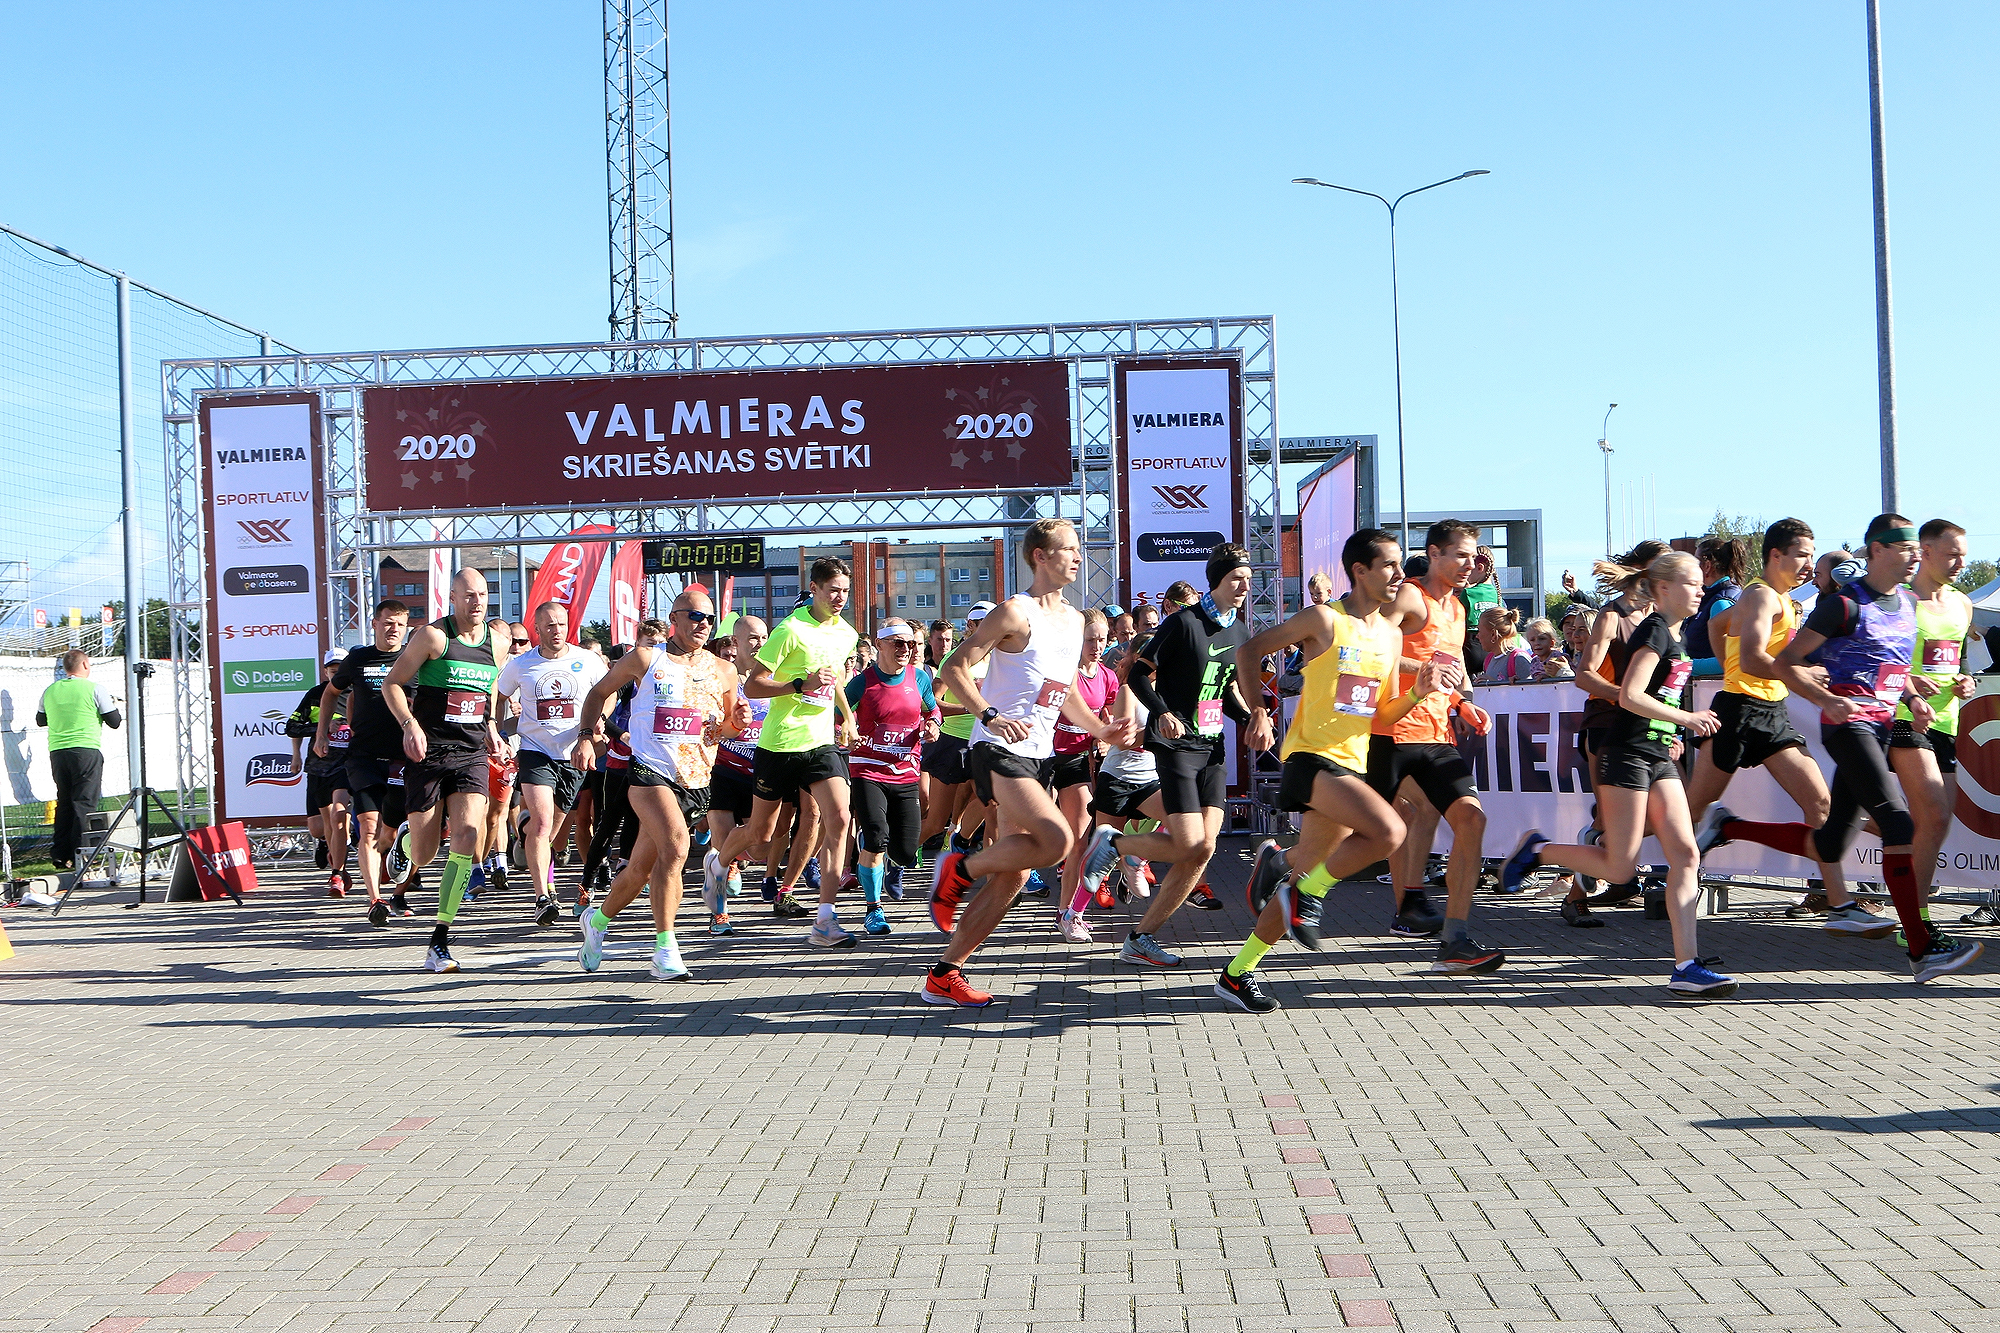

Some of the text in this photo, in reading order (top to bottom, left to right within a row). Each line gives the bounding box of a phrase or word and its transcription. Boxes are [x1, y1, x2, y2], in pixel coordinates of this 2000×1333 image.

[565, 395, 866, 445] VALMIERAS
[955, 412, 1034, 440] 2020
[1132, 412, 1225, 428] VALMIERA
[400, 433, 477, 461] 2020
[216, 446, 307, 465] VALMIERA
[562, 441, 872, 479] SKRIEŠANAS SVĒTKI
[1131, 457, 1228, 470] SPORTLAT.LV
[216, 491, 310, 506] SPORTLAT.LV
[662, 543, 760, 567] 00:00:03
[242, 623, 318, 638] SPORTLAND
[1932, 647, 1955, 662] 210
[253, 670, 304, 684] Dobele
[450, 666, 491, 681] VEGAN
[1883, 673, 1906, 688] 406
[1351, 685, 1370, 703] 89
[460, 700, 476, 713] 98
[548, 705, 563, 717] 92
[1204, 708, 1221, 722] 279
[664, 716, 693, 731] 387
[883, 731, 905, 743] 571
